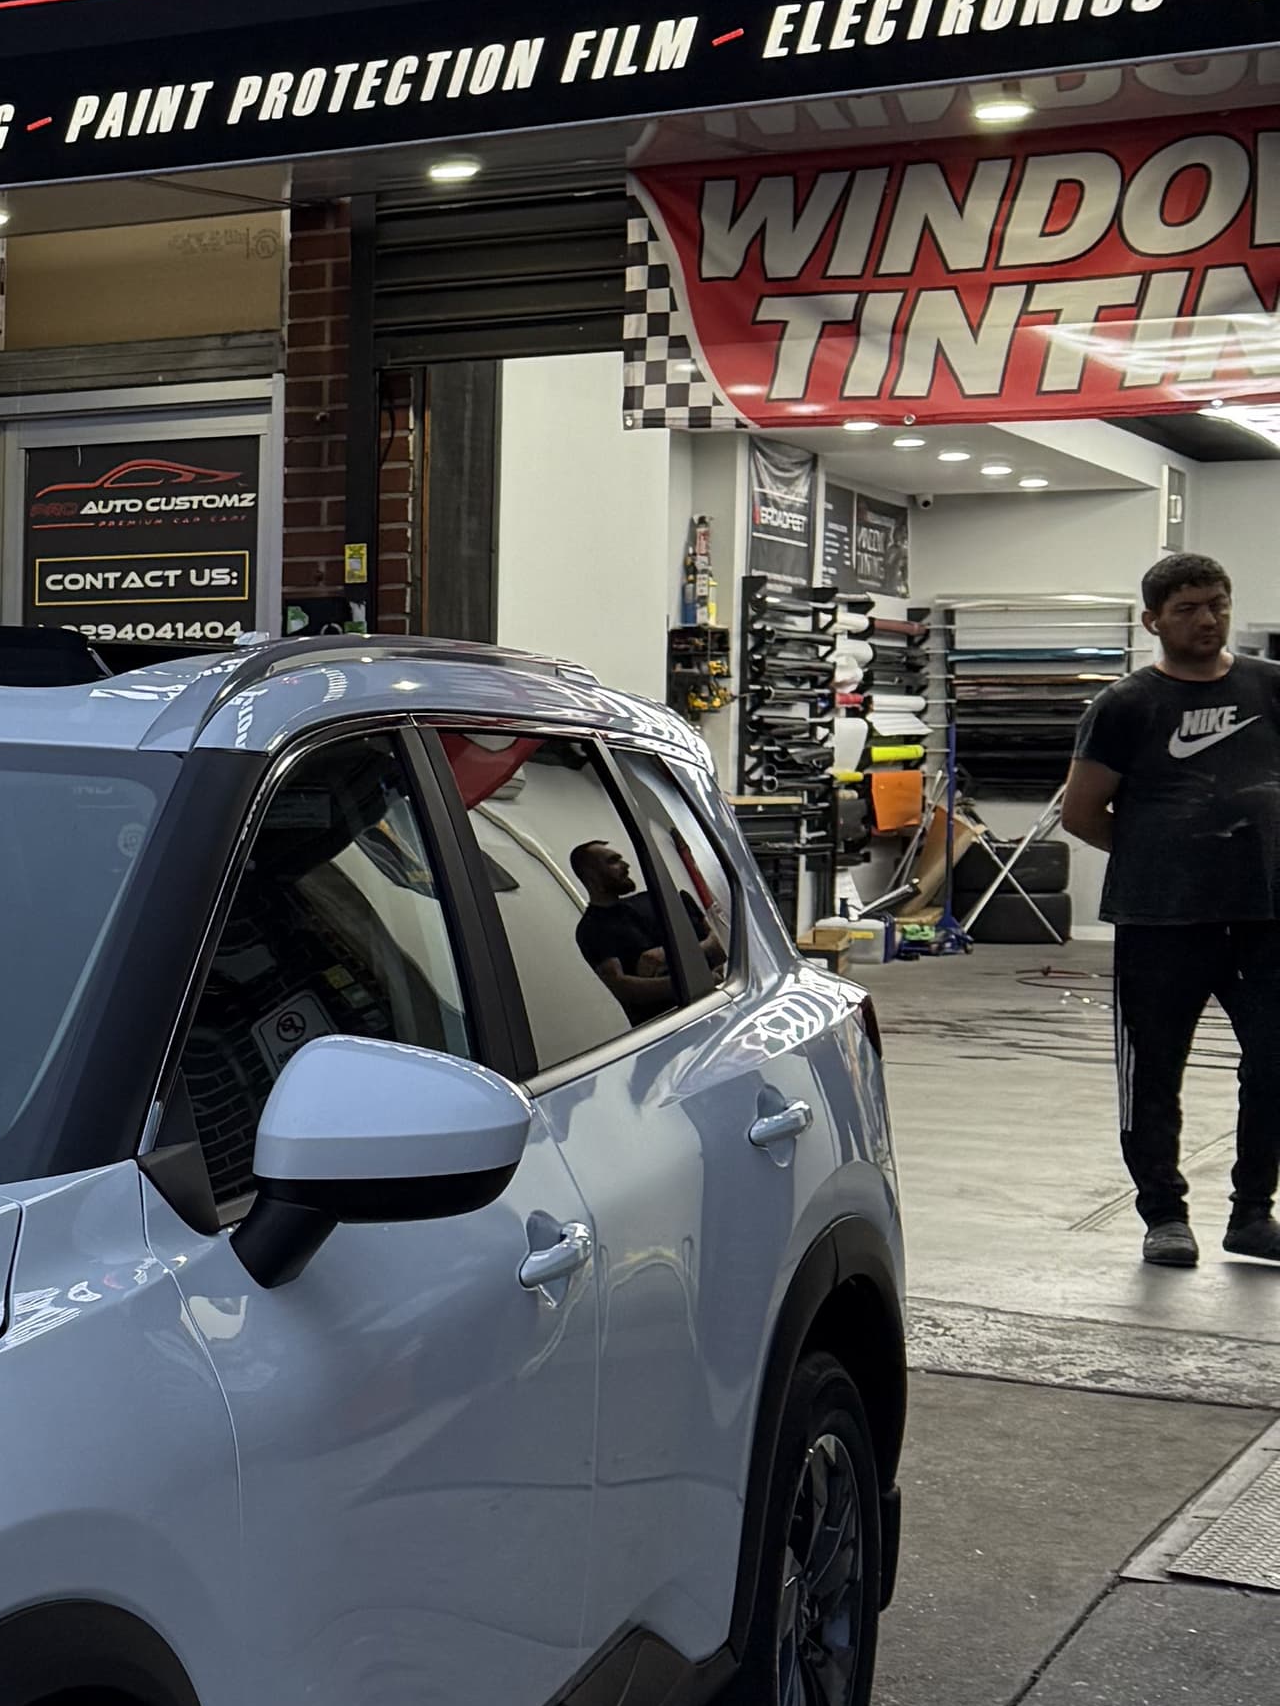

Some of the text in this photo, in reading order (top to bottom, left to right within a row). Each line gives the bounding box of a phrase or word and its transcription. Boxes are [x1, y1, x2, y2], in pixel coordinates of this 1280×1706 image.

[64, 81, 213, 144] PAINT
[226, 36, 545, 127] PROTECTION
[559, 15, 700, 85] FILM
[698, 128, 1280, 282] WINDO
[80, 499, 142, 515] AUTO
[145, 493, 256, 512] CUSTOMZ
[45, 568, 238, 590] CONTACT US:
[1180, 706, 1238, 737] NIKE
